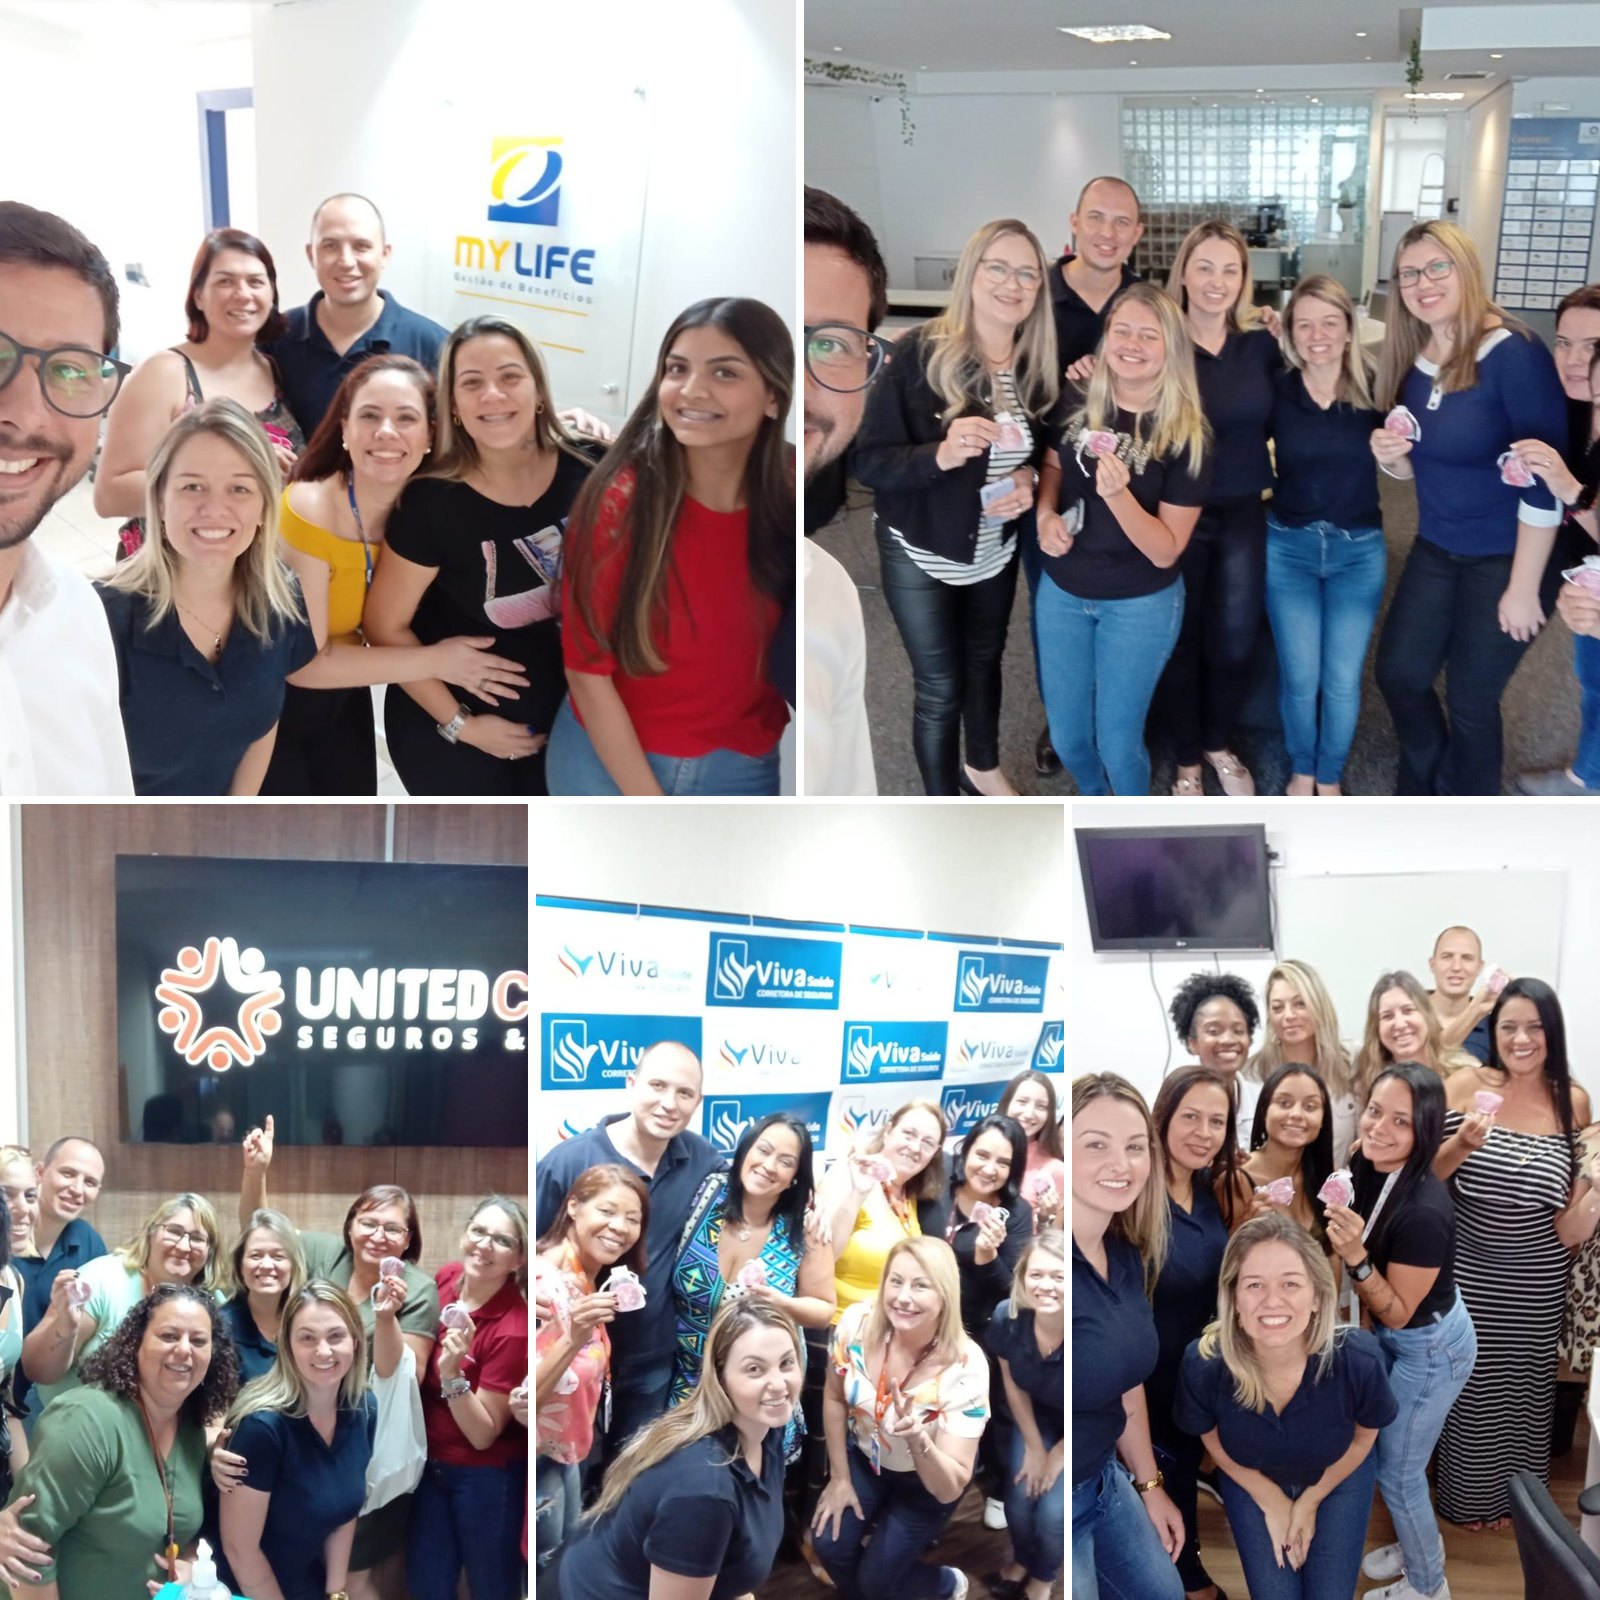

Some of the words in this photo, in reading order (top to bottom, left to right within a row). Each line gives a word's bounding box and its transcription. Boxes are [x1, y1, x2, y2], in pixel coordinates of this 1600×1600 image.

[500, 281, 512, 290] de
[598, 951, 658, 978] Viva
[756, 960, 807, 987] Viva
[989, 973, 1023, 994] Viva
[297, 1026, 478, 1050] SEGUROS
[504, 1028, 526, 1050] &
[877, 1041, 920, 1063] Viva
[981, 1041, 1014, 1059] Viva
